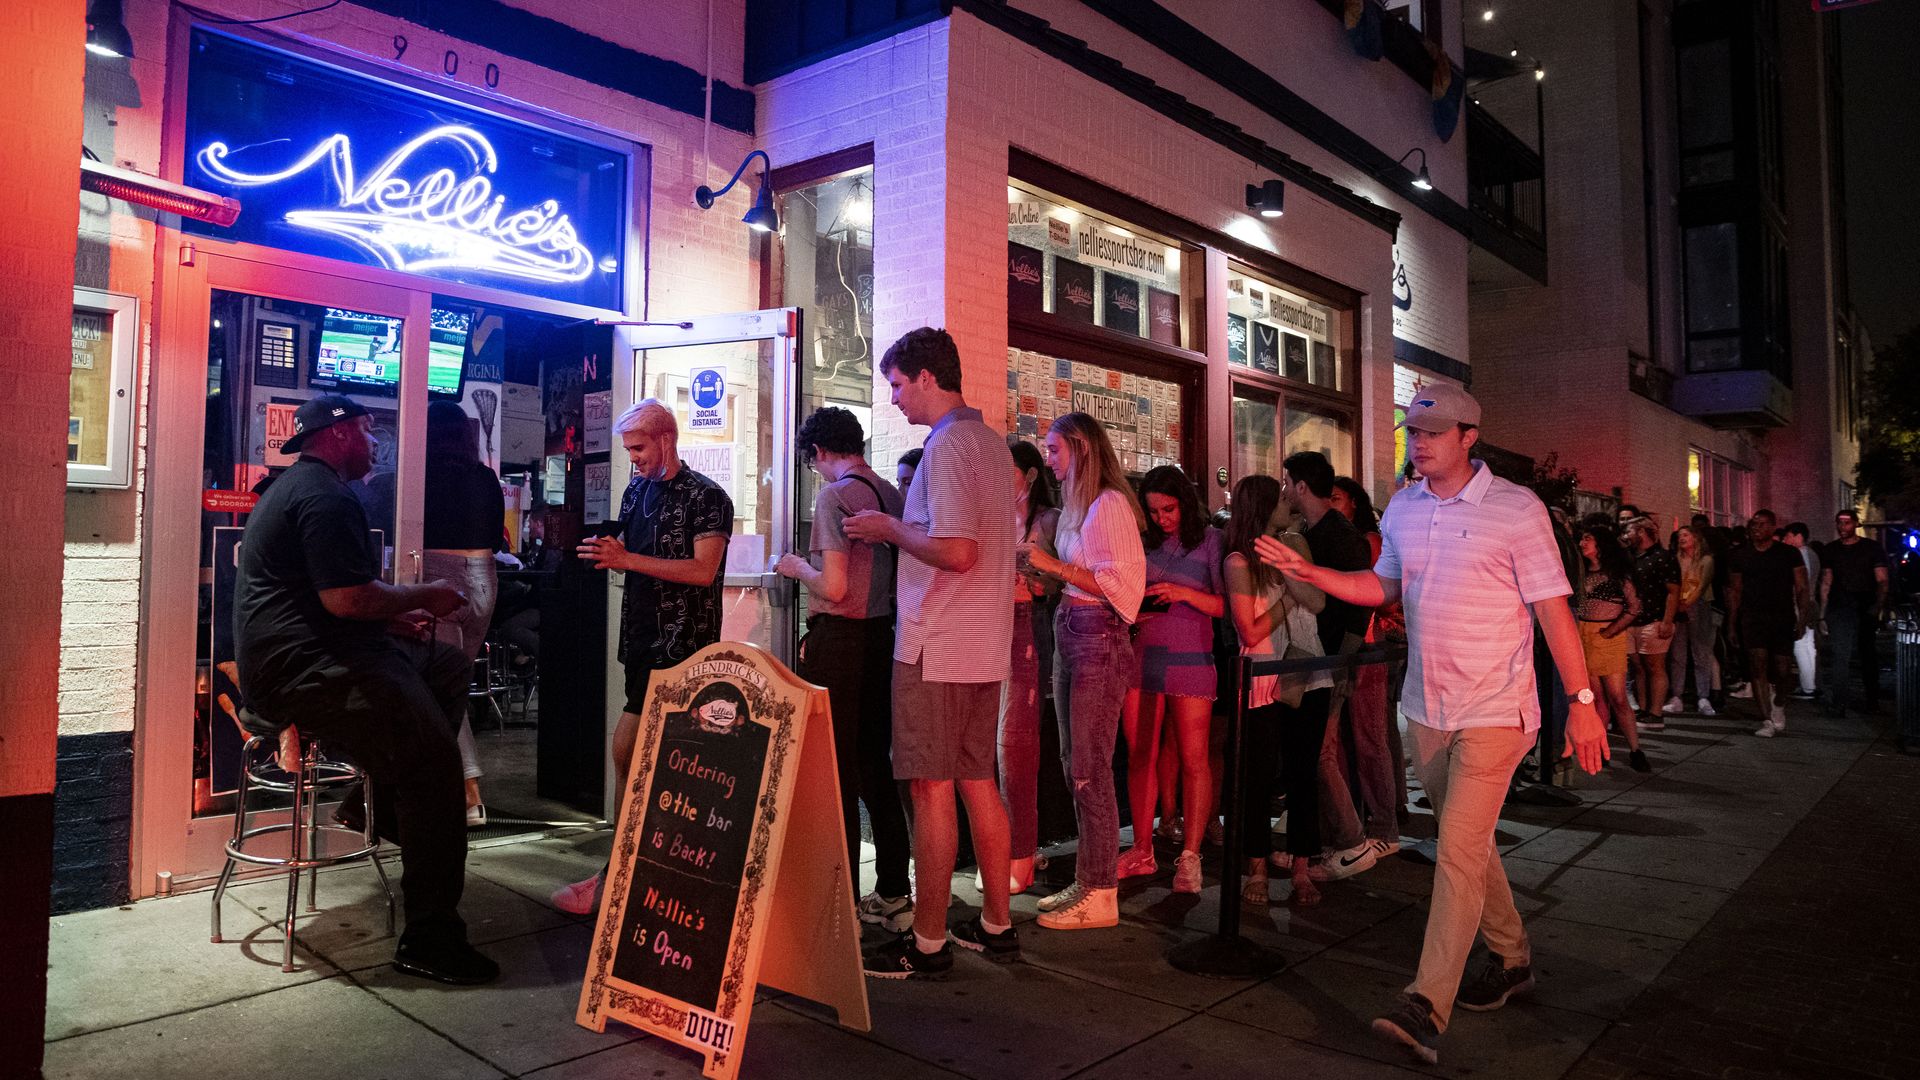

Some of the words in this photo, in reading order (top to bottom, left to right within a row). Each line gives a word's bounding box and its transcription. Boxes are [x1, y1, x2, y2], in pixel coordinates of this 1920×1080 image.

[393, 34, 500, 88] 900
[204, 125, 582, 251] Nellie's
[1008, 204, 1018, 225] der
[1018, 203, 1039, 225] Online
[1049, 218, 1069, 234] Nellie's
[1049, 231, 1070, 245] T-Shirts
[1079, 226, 1165, 275] nelliessportsbar.com
[1270, 294, 1326, 335] nelliessportsbar.com
[72, 317, 100, 340] ACK!
[353, 323, 378, 333] meijer
[444, 332, 466, 344] meije
[467, 363, 501, 380] IRGINIA
[696, 410, 718, 418] SOCIAL
[1075, 392, 1091, 414] SAY
[1093, 395, 1114, 421] THEIR
[1115, 401, 1137, 425] NAMES
[268, 408, 296, 437] ENT
[692, 418, 722, 427] DISTANCE
[692, 662, 761, 685] HENDRICK'S
[706, 701, 734, 716] Nellie's
[668, 749, 736, 799] Ordering
[659, 790, 698, 821] @the
[706, 807, 733, 832] bar
[652, 826, 664, 848] is
[643, 886, 705, 931] Nellie's
[633, 924, 647, 947] is
[653, 931, 693, 970] Open
[685, 1010, 735, 1051] DUH!
